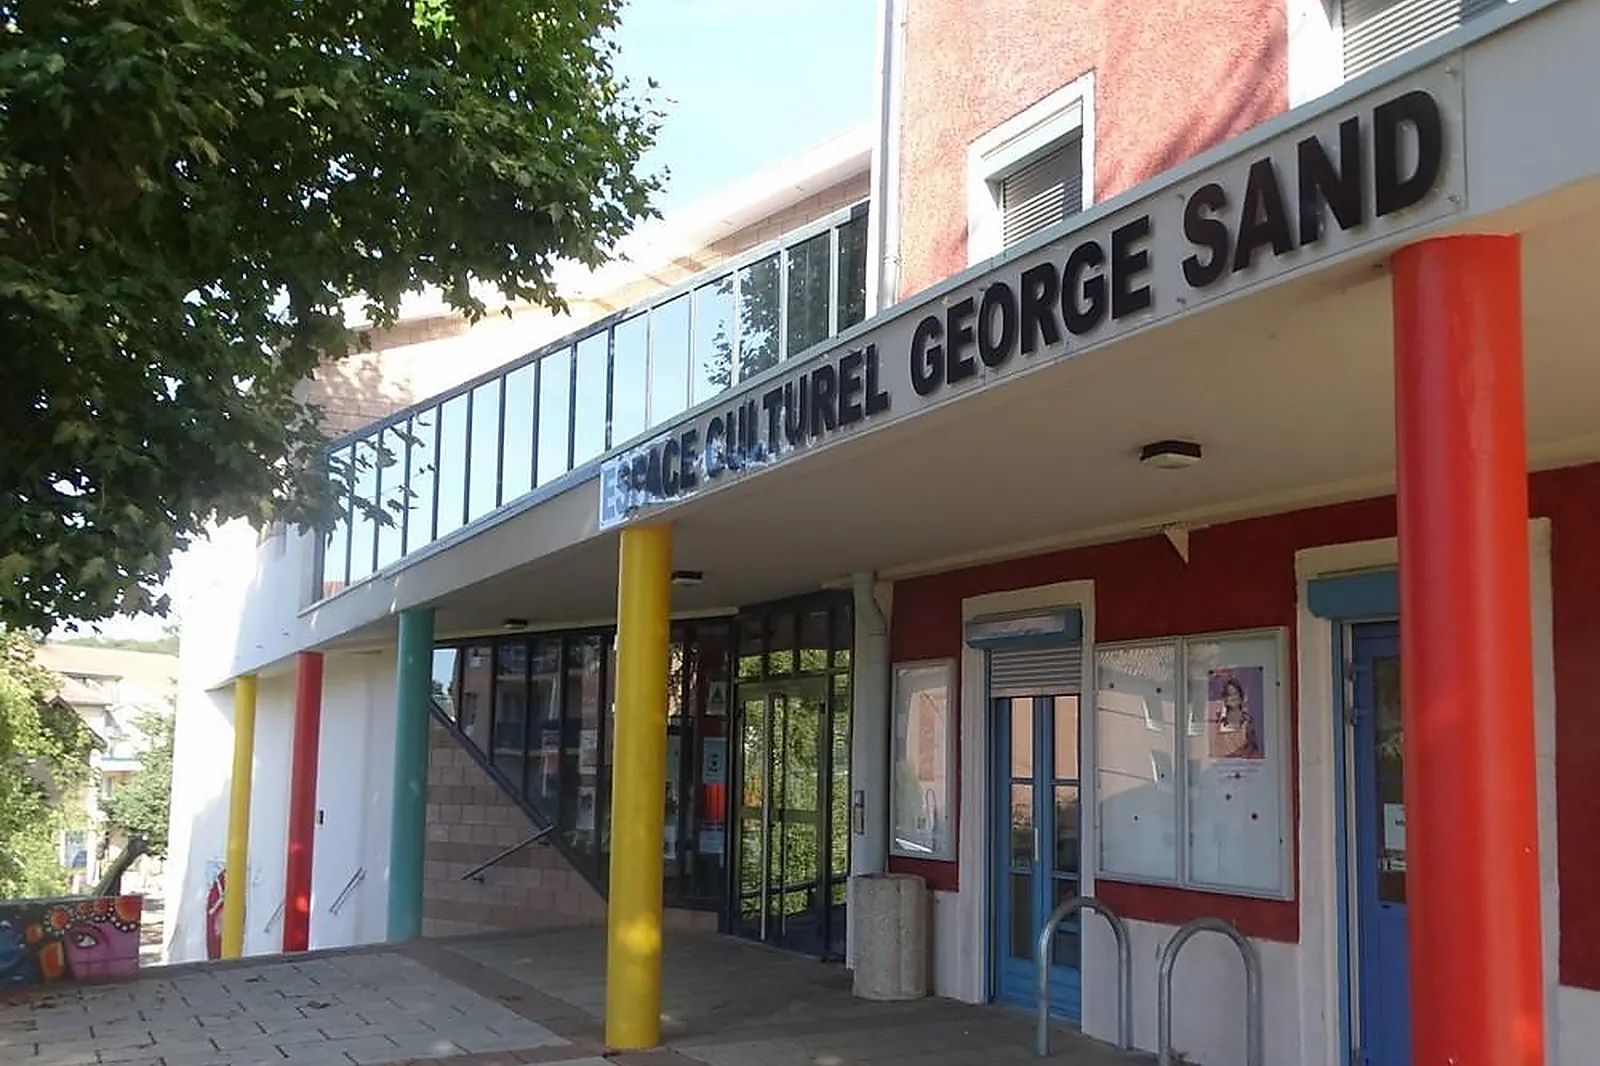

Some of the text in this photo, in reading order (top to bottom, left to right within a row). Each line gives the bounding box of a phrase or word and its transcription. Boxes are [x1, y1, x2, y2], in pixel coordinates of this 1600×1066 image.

[705, 343, 890, 477] CULTUREL
[910, 214, 1152, 396] GEORGE
[1182, 90, 1442, 288] SAND
